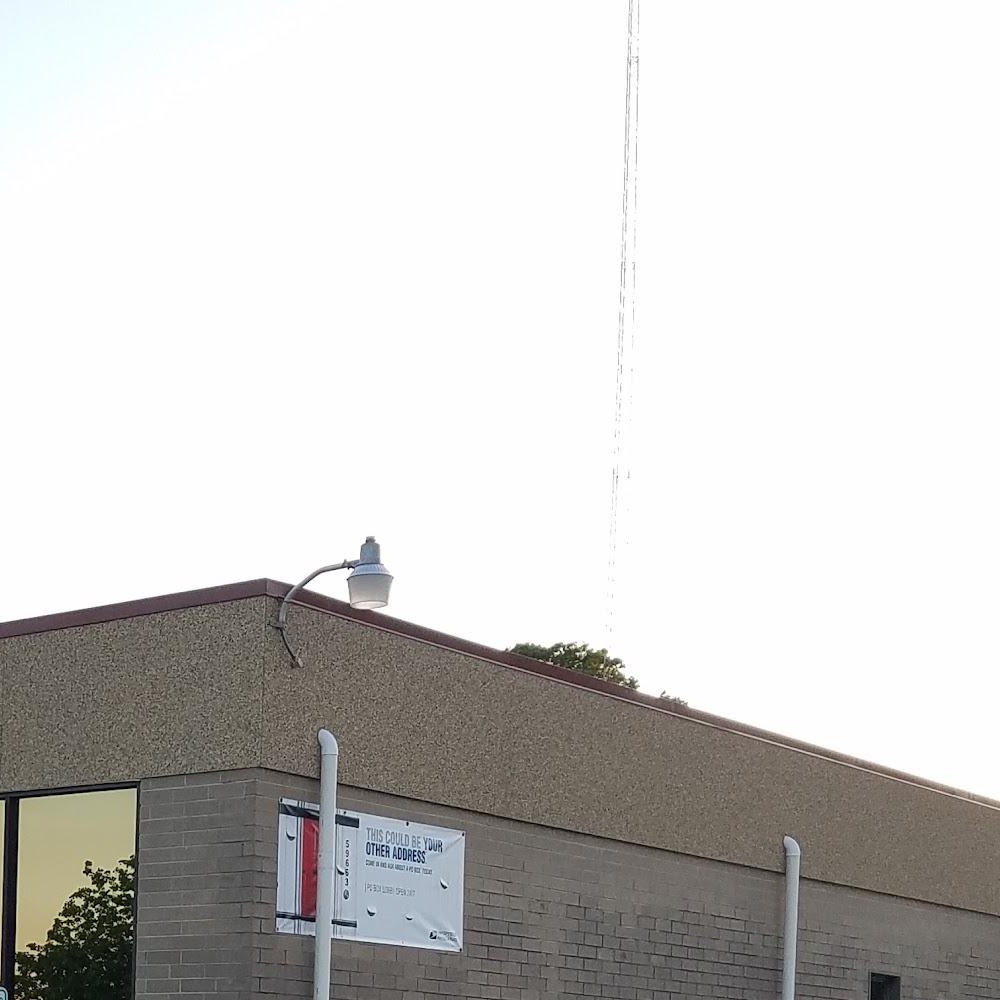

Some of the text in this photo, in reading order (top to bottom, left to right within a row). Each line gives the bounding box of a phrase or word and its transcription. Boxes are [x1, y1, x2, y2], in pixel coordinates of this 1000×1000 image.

[365, 841, 391, 858] OTHER
[366, 827, 443, 853] THIS COULD BE YOUR
